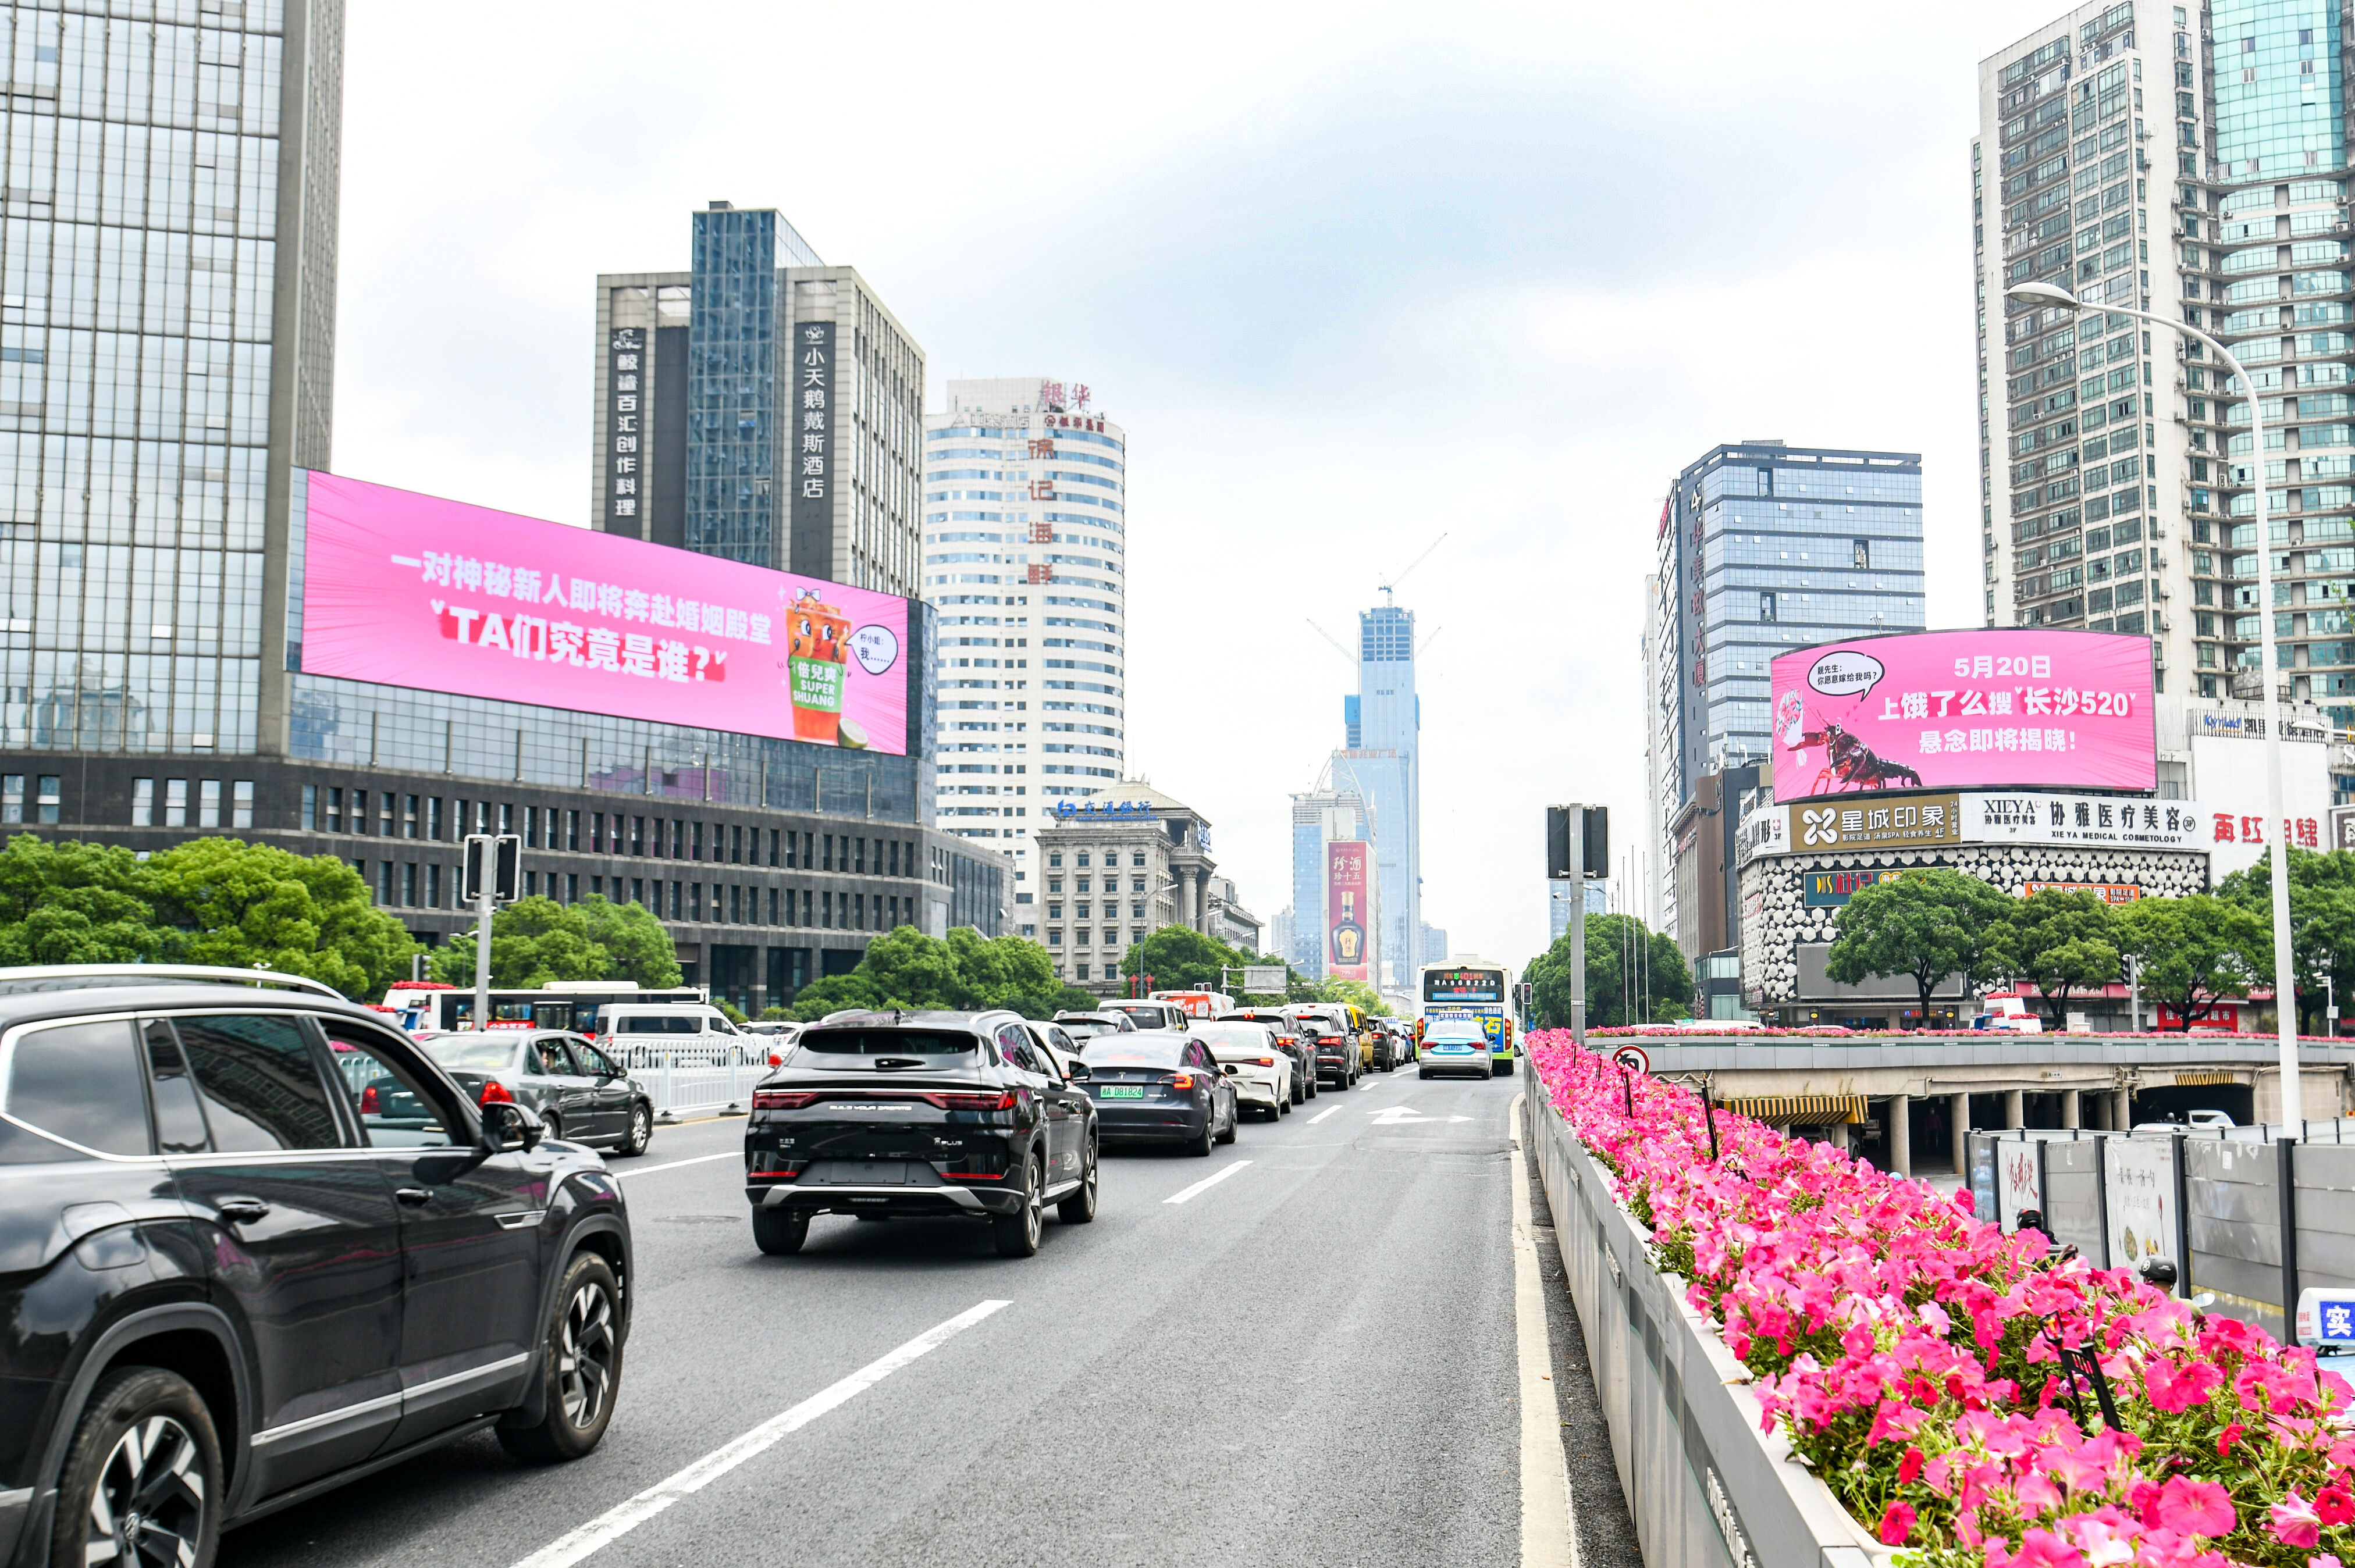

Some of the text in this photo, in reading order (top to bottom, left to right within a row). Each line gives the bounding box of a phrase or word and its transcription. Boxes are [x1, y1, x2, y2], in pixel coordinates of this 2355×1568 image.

[802, 347, 825, 498] 小天鹅戴斯酒店
[391, 550, 772, 645] 一对神秘新人即将奔赴婚姻殿堂
[1692, 522, 1706, 688] 华美欧大厦
[1954, 655, 2051, 679] 5月20日
[793, 691, 835, 707] SHUANG
[800, 679, 835, 696] SUPER
[2204, 714, 2242, 728] Kyriad
[1841, 805, 1945, 832] 星城印象
[1950, 800, 1959, 836] 24小时营业
[1984, 814, 2036, 825] 协雅医疗美容
[2050, 800, 2180, 832] 协雅医疗美容
[1842, 828, 1944, 842] 影院足道 汤泉SPA 轻食养生 4F
[2082, 832, 2118, 840] MEDICAL
[2123, 833, 2182, 843] COSMETOLOGY
[1115, 1087, 1141, 1096] D81824
[2326, 1305, 2353, 1337] 实
